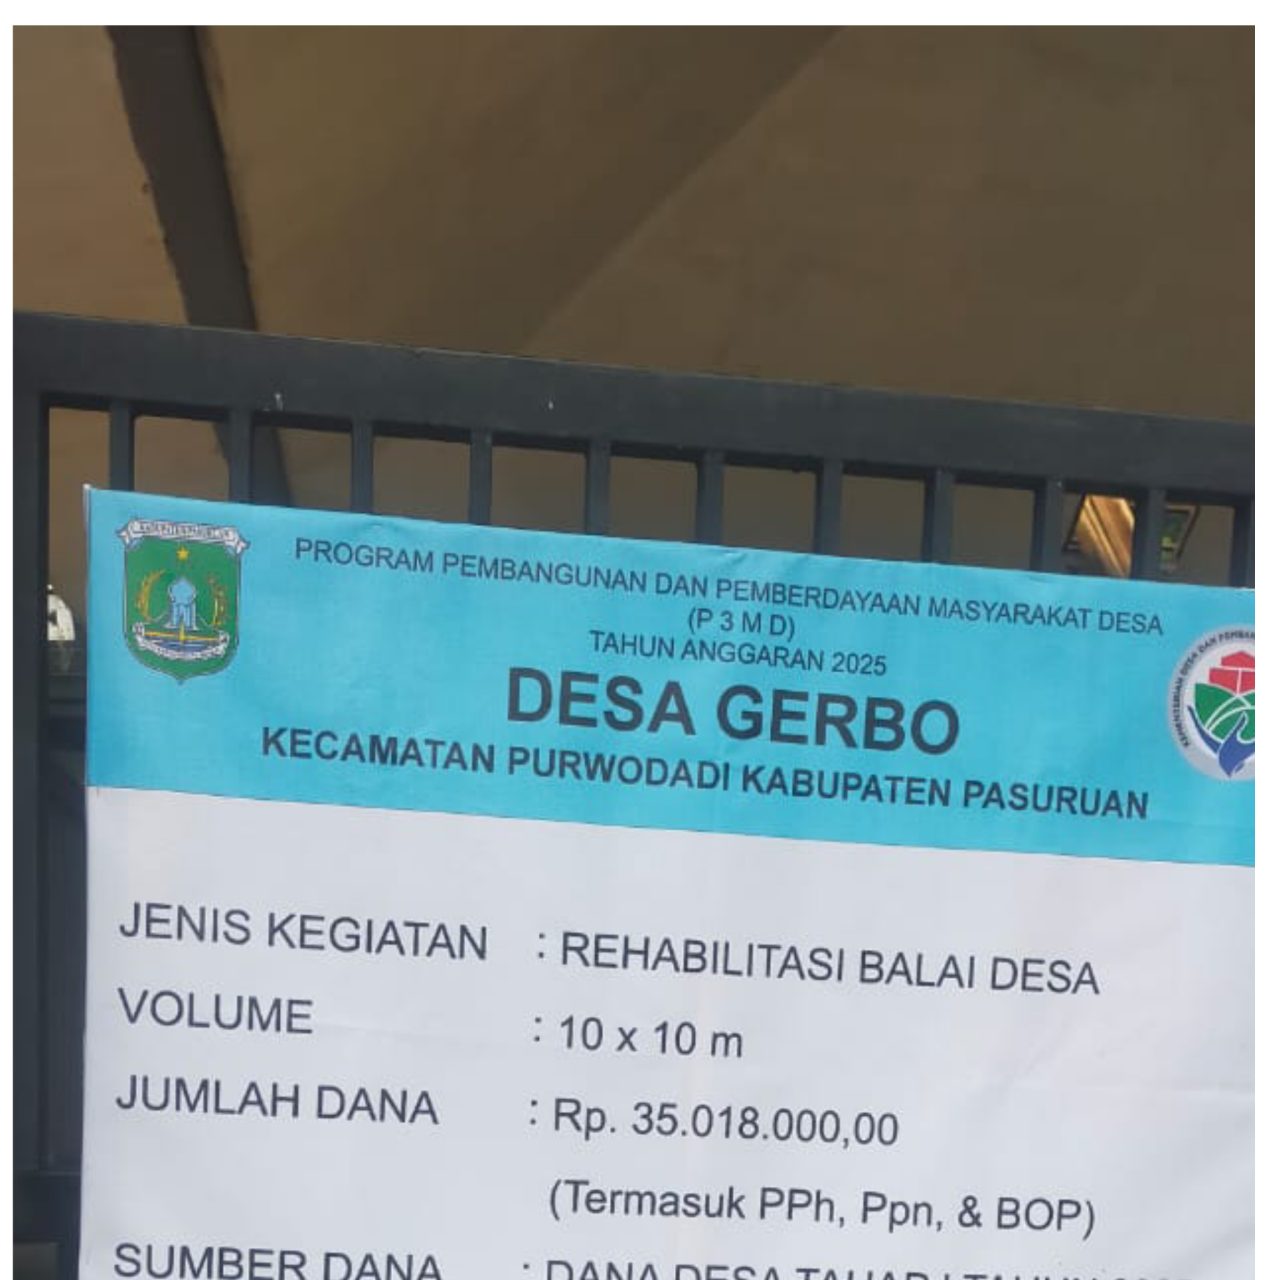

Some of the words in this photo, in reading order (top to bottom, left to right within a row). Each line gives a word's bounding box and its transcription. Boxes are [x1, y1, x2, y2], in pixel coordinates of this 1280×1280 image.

[295, 537, 434, 573] PROGRAM
[442, 552, 647, 593] PEMBANGUNAN
[655, 572, 708, 598] DAN
[716, 578, 921, 615] PEMBERDAYAAN
[927, 596, 1093, 630] MASYARAKAT
[1098, 609, 1164, 636] DESA
[687, 607, 714, 635] (P
[719, 609, 735, 633] 3
[742, 611, 762, 634] M
[769, 613, 796, 641] D)
[589, 629, 675, 659] TAHUN
[680, 641, 823, 672] ANGGARAN
[831, 651, 887, 677] 2025
[507, 667, 696, 736] DESA
[716, 684, 960, 756] GERBO
[262, 726, 495, 773] KECAMATAN
[508, 746, 731, 791] PURWODADI
[742, 764, 951, 807] KABUPATEN
[963, 779, 1149, 819] PASURUAN
[119, 901, 251, 946] JENIS
[268, 912, 487, 961] KEGIATAN
[562, 931, 844, 982] REHABILITASI
[859, 949, 975, 989] BALAI
[990, 956, 1100, 995] DESA
[117, 987, 313, 1034] VOLUME
[560, 1015, 604, 1051] 10
[616, 1026, 637, 1052] x
[654, 1021, 697, 1056] 10
[710, 1032, 743, 1058] m
[115, 1074, 300, 1118] JUMLAH
[316, 1085, 439, 1125] DANA
[554, 1097, 616, 1141] Rp.
[632, 1101, 899, 1149] 35.018.000,00
[549, 1179, 746, 1221] (Termasuk
[759, 1186, 845, 1228] PPh,
[861, 1191, 943, 1234] Ppn,
[957, 1195, 983, 1228] &
[997, 1196, 1095, 1240] BOP)
